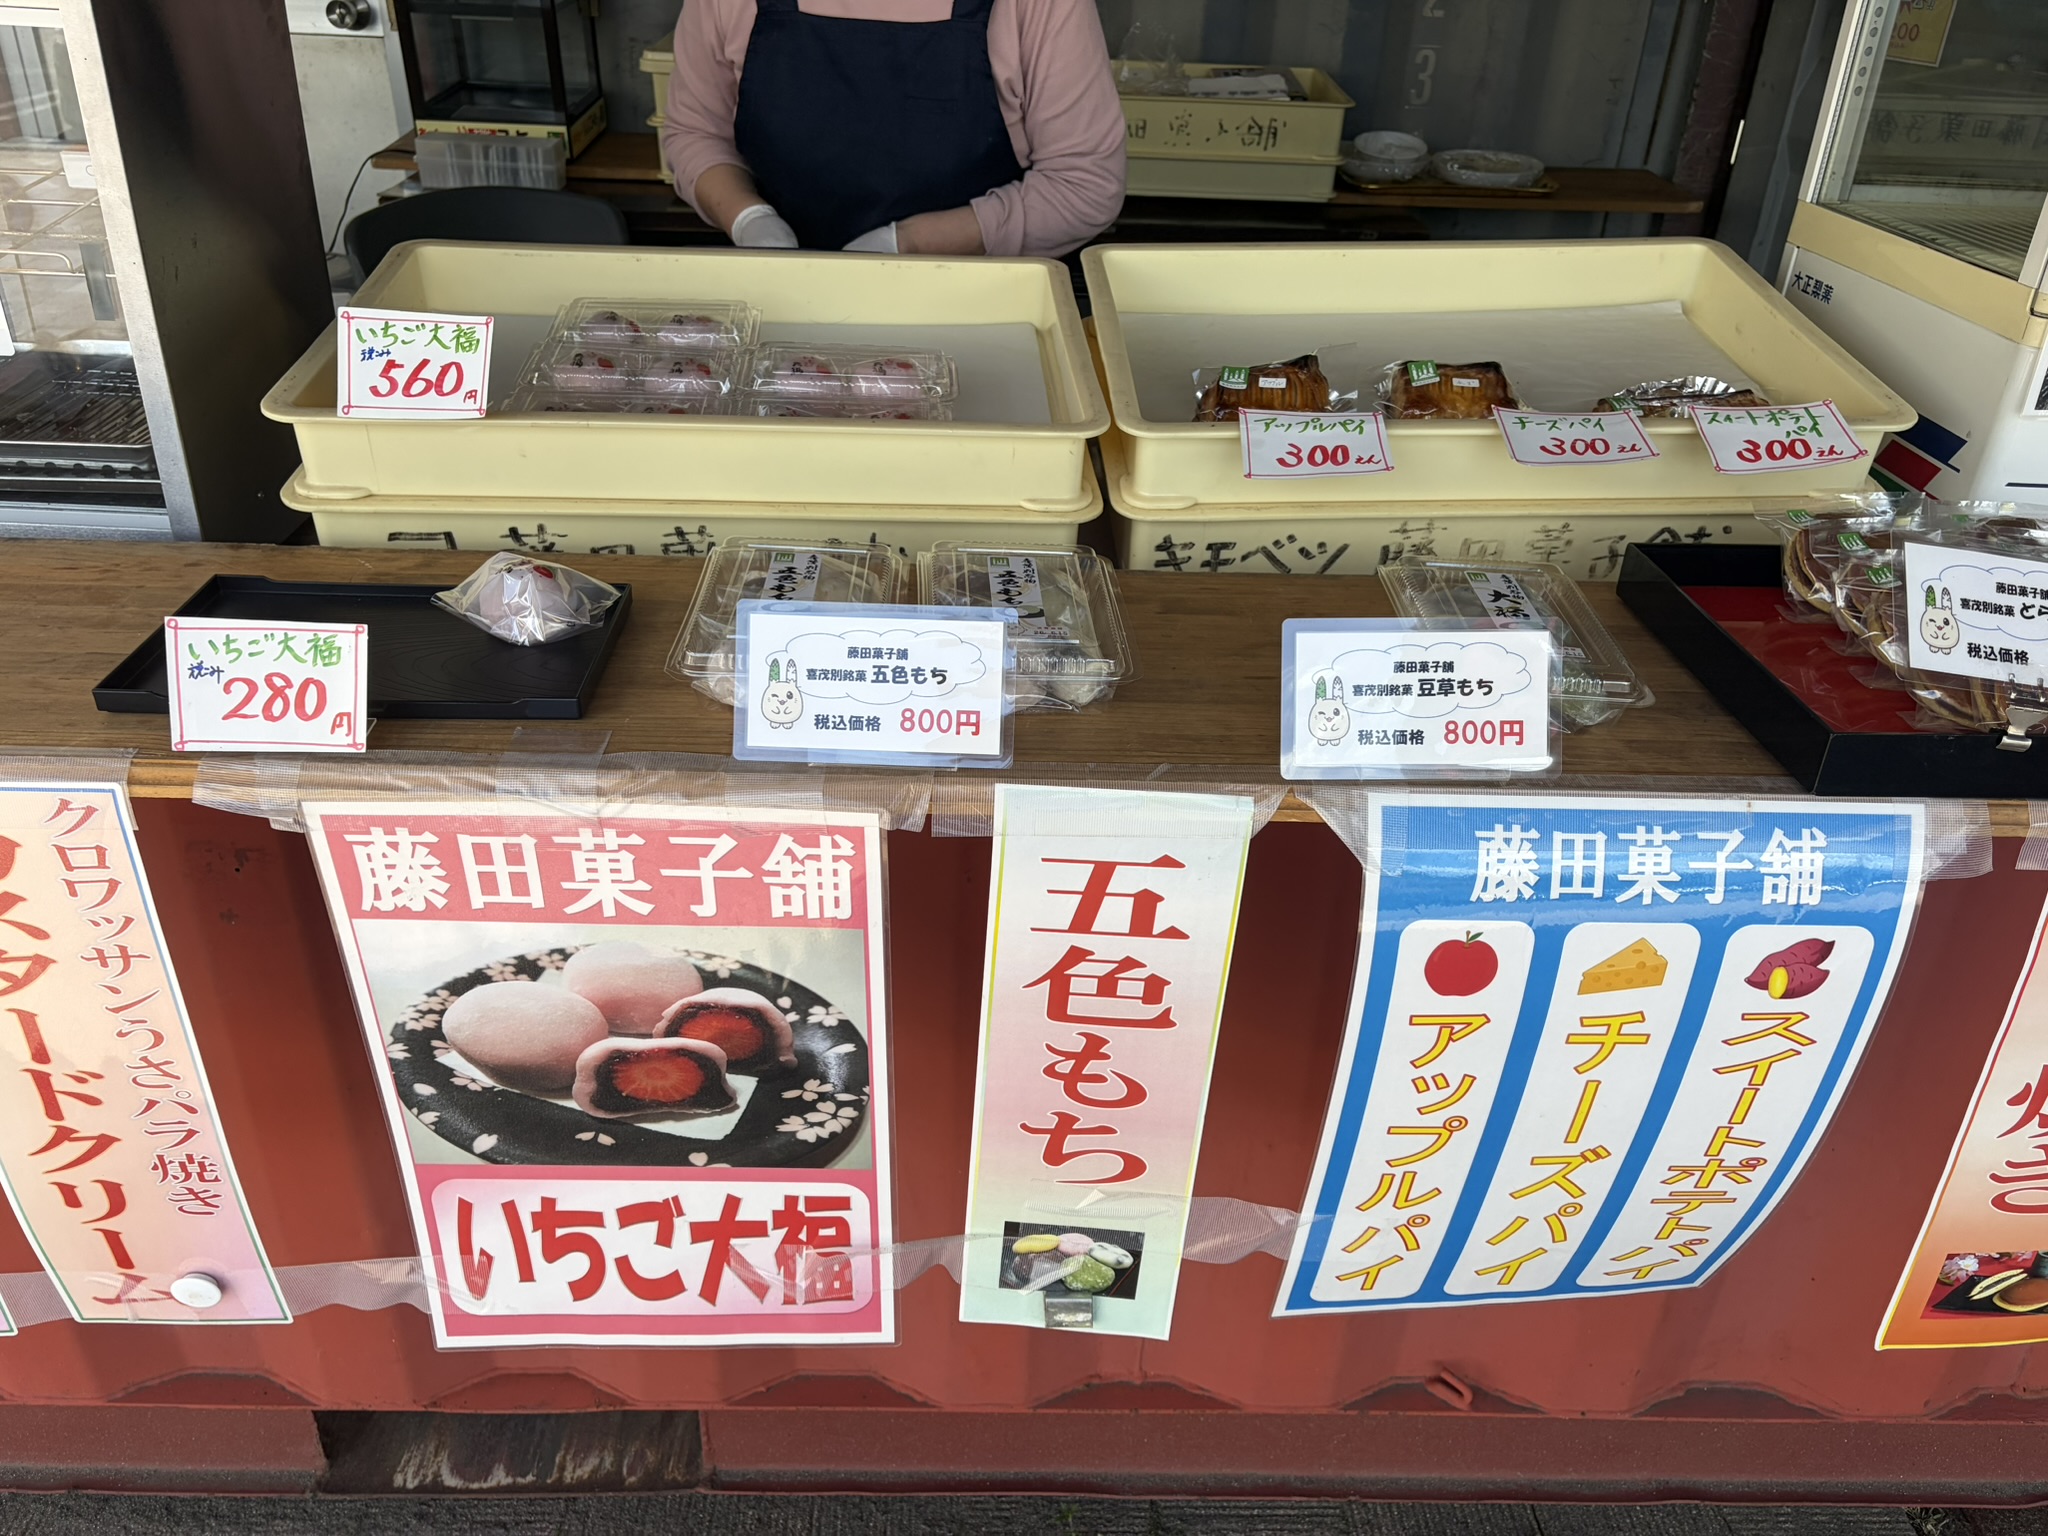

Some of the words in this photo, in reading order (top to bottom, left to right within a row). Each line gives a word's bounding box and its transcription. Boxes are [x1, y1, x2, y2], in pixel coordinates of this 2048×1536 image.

[355, 321, 481, 354] いちご大福
[1254, 417, 1366, 436] アップルパイ
[1512, 416, 1606, 433] チーズパイ
[1960, 597, 2015, 617] 喜茂別銘菓
[188, 632, 342, 667] いちご大福
[847, 646, 909, 661] 藤田菓子舗
[1967, 642, 2030, 666] 税込価格
[806, 668, 867, 683] 喜茂別銘菓
[871, 665, 948, 685] 五色もち
[1393, 660, 1455, 674] 藤田菓子舗
[1352, 684, 1413, 697] 喜茂別銘菓
[1417, 677, 1494, 697] 豆草もち
[814, 714, 882, 732] 税込価格
[900, 708, 981, 737] 800円
[1357, 729, 1425, 746] 税込価格
[1443, 720, 1524, 746] 800円
[343, 827, 857, 920] 藤田菓子舗
[1468, 822, 1828, 907] 藤田菓子舗
[44, 798, 223, 1216] クロワッサンうさパラ焼き
[1019, 854, 1191, 1184] 五色もち
[0, 835, 173, 1305] スタードクリーム
[1335, 1013, 1491, 1292] アップルパイ
[1474, 1010, 1651, 1286] チーズパイ
[1603, 1012, 1818, 1280] スイートポテトパイ
[456, 1193, 855, 1307] いちご大福
